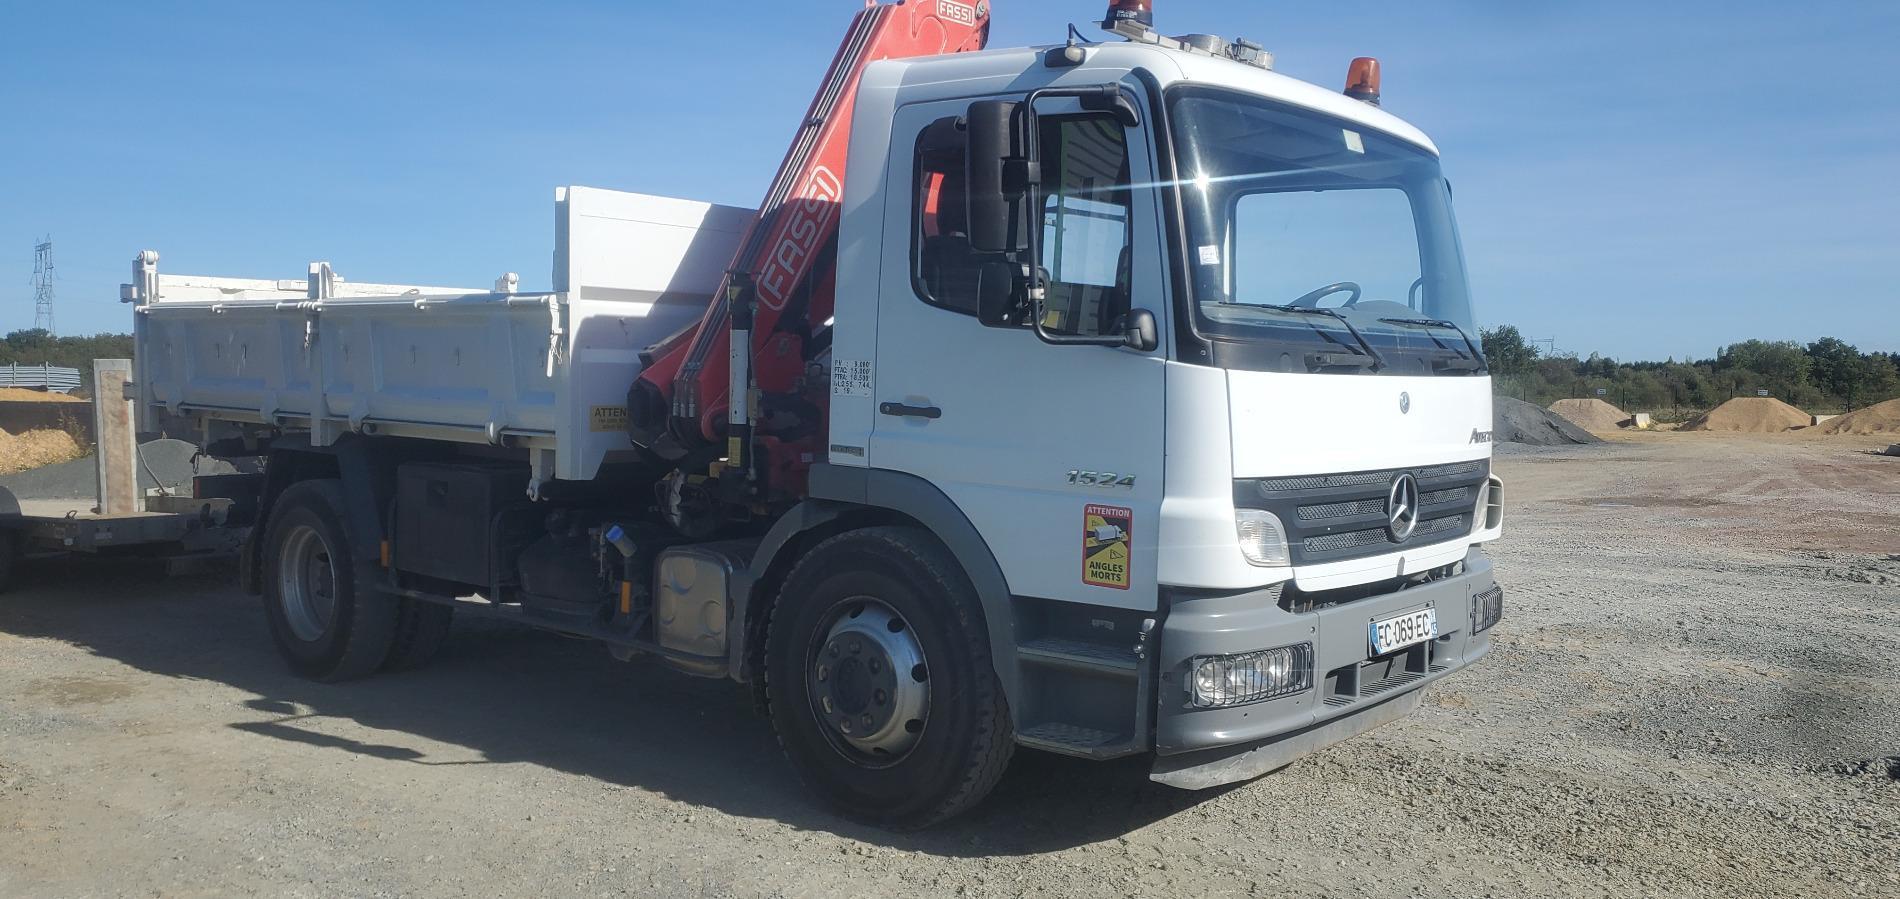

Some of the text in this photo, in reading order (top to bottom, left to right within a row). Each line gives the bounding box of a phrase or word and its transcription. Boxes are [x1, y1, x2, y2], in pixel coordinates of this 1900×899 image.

[940, 2, 972, 22] FASSI
[763, 176, 835, 300] FASSI
[595, 407, 628, 417] ATTEN
[1066, 469, 1136, 490] 1524
[1087, 506, 1130, 517] ATTENTION
[1089, 561, 1123, 573] ANGLES
[1090, 570, 1121, 582] MORTS
